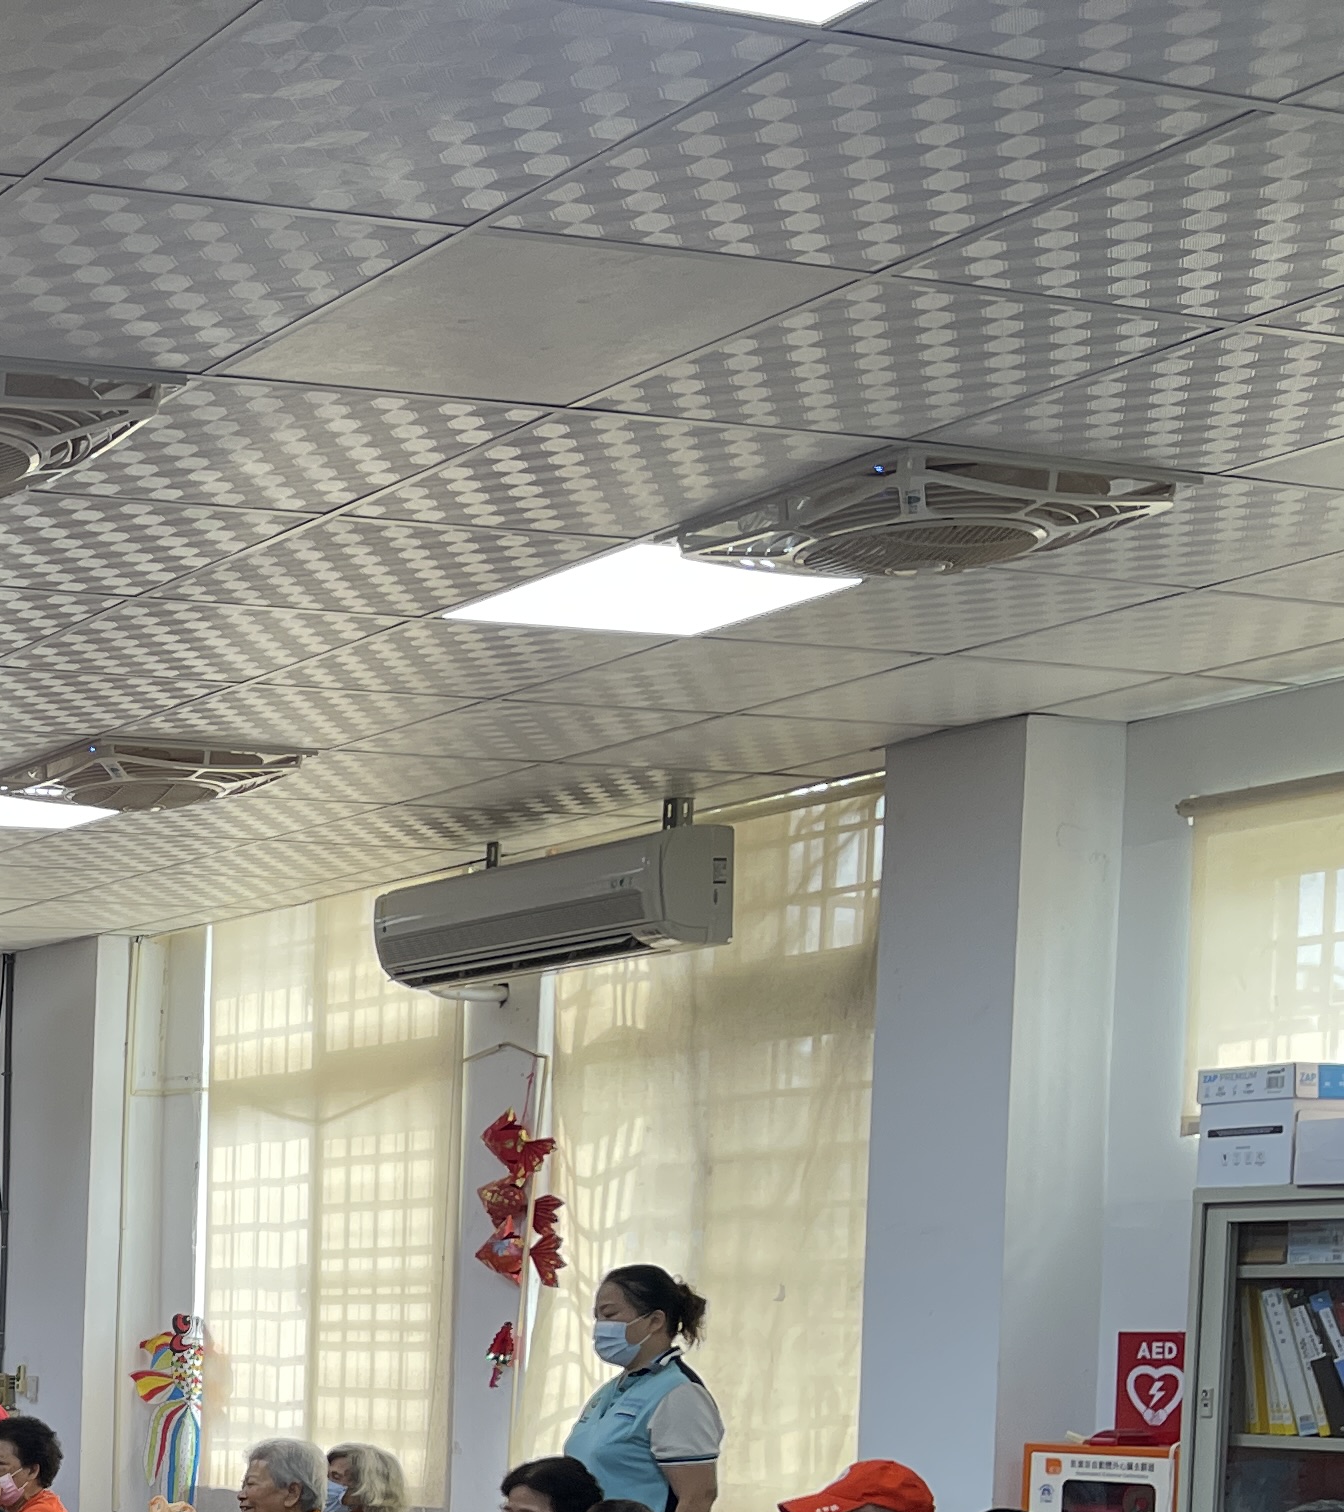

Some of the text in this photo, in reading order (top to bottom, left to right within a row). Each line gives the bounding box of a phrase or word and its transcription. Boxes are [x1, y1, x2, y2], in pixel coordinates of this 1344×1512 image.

[1203, 1072, 1257, 1083] ZAP PREMIUM
[1300, 1072, 1316, 1082] ZAP
[1136, 1341, 1177, 1359] AED
